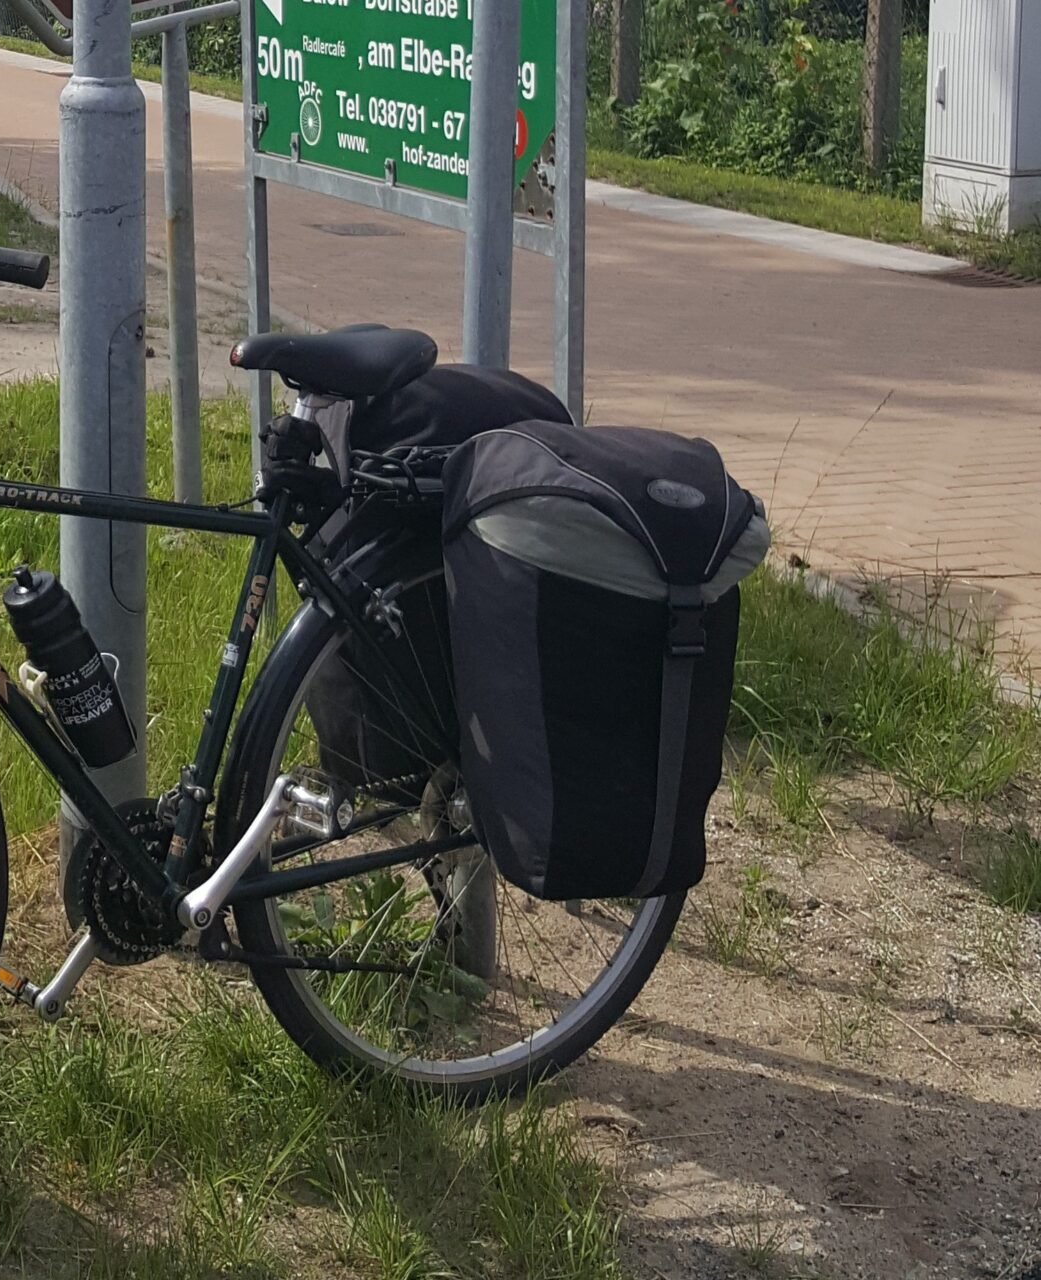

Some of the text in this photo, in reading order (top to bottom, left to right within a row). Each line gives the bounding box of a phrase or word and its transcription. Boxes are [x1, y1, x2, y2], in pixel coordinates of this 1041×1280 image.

[258, 35, 281, 79] 50
[302, 35, 346, 58] Radlercafé
[368, 40, 395, 70] am
[401, 37, 536, 100] Elbe-Rag
[298, 80, 323, 105] ADFC
[336, 90, 364, 122] Tel.
[369, 97, 425, 134] 038791
[444, 111, 465, 141] 67
[337, 132, 369, 154] www.
[240, 574, 269, 633] 730
